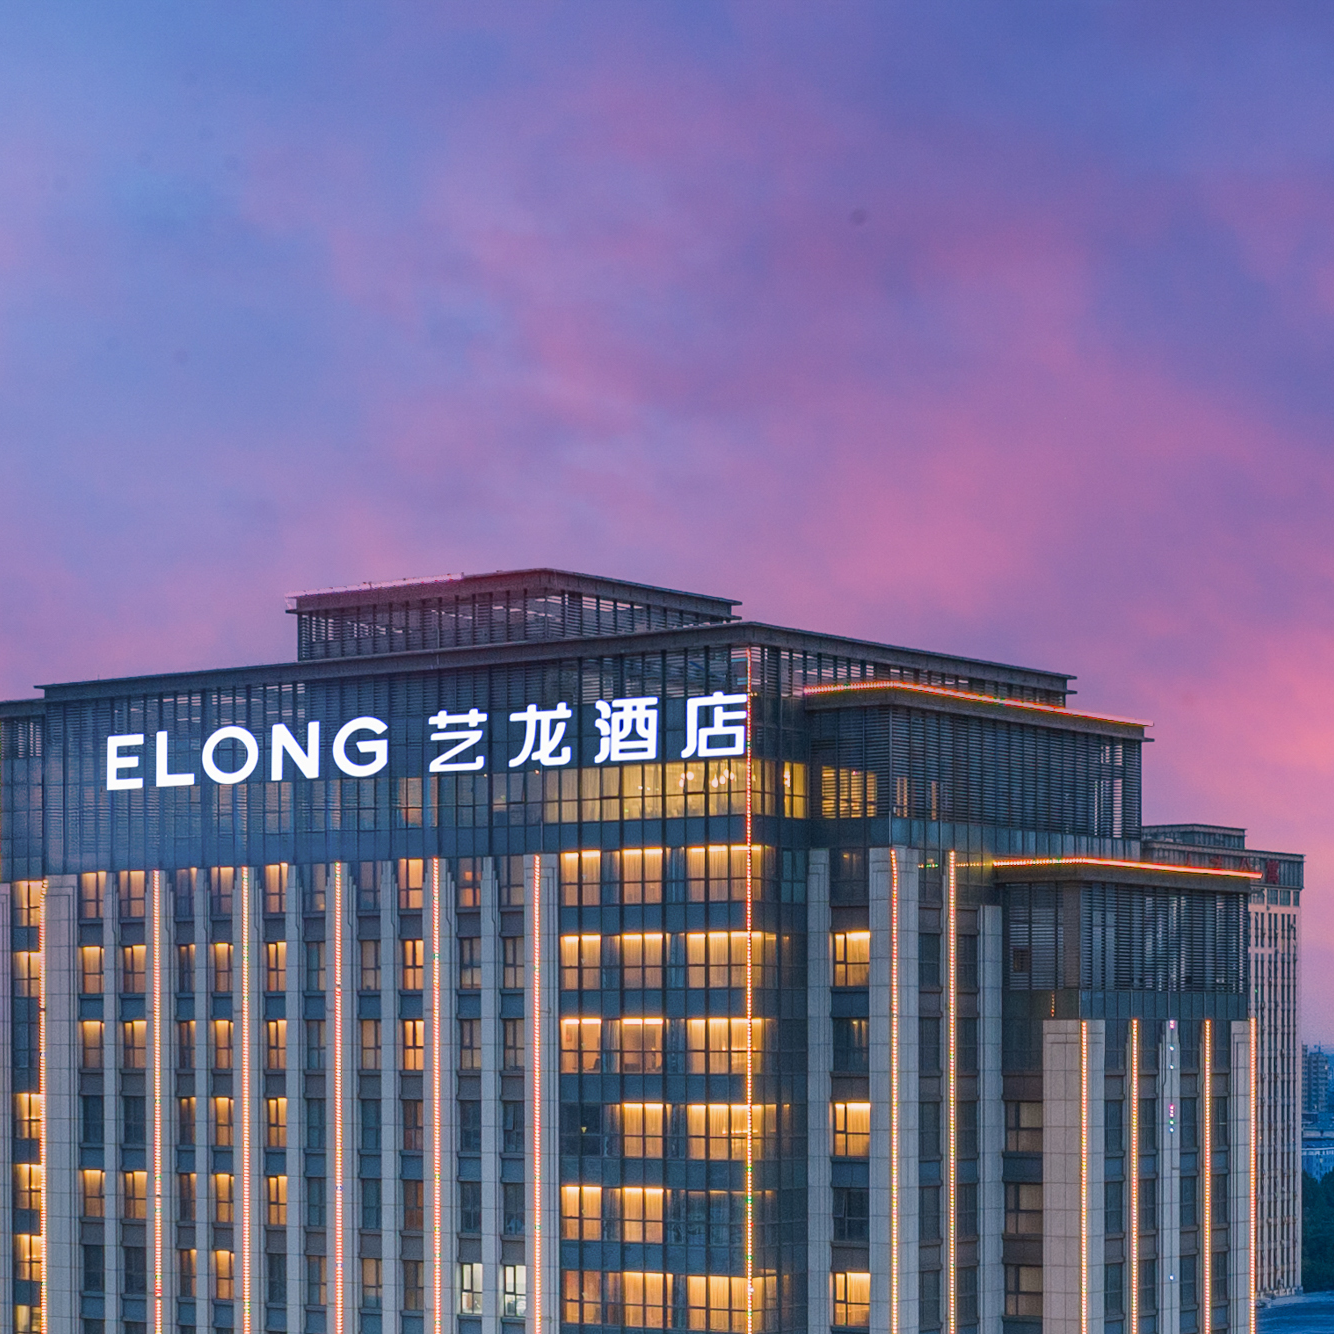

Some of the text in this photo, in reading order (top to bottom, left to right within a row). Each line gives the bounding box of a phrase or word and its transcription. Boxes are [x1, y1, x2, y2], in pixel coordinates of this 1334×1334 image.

[105, 690, 750, 791] ELONG 艺龙酒店
